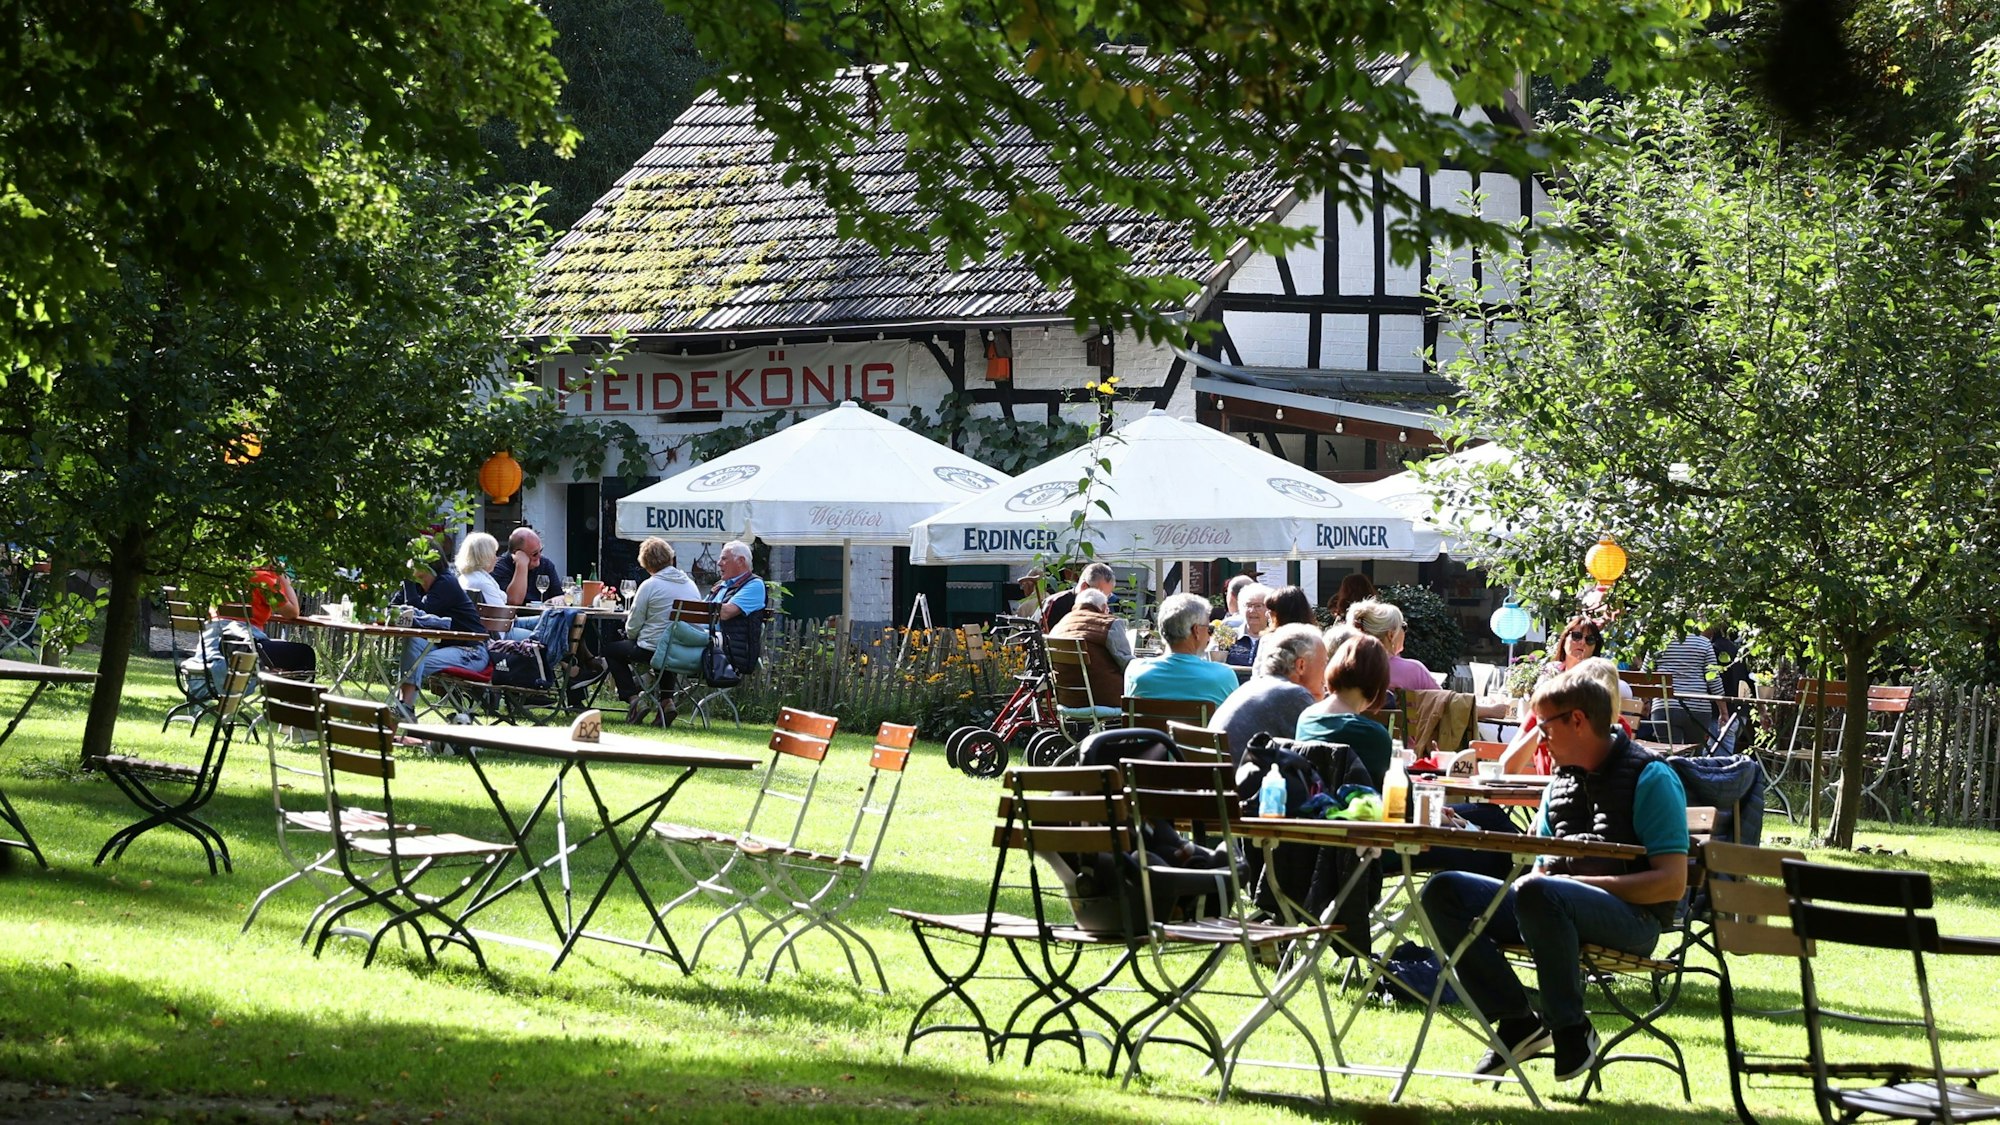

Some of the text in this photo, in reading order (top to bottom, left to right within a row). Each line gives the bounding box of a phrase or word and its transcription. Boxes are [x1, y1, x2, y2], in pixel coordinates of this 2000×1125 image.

[558, 351, 895, 411] HEIDEKÖNIG
[646, 506, 726, 531] ERDINGER
[808, 505, 883, 530] Weißbier
[963, 527, 1060, 553] ERDINGER
[1152, 523, 1232, 549] Weißbier
[1316, 523, 1389, 549] ERDINGER
[578, 721, 600, 739] B25
[1453, 760, 1474, 775] B24
